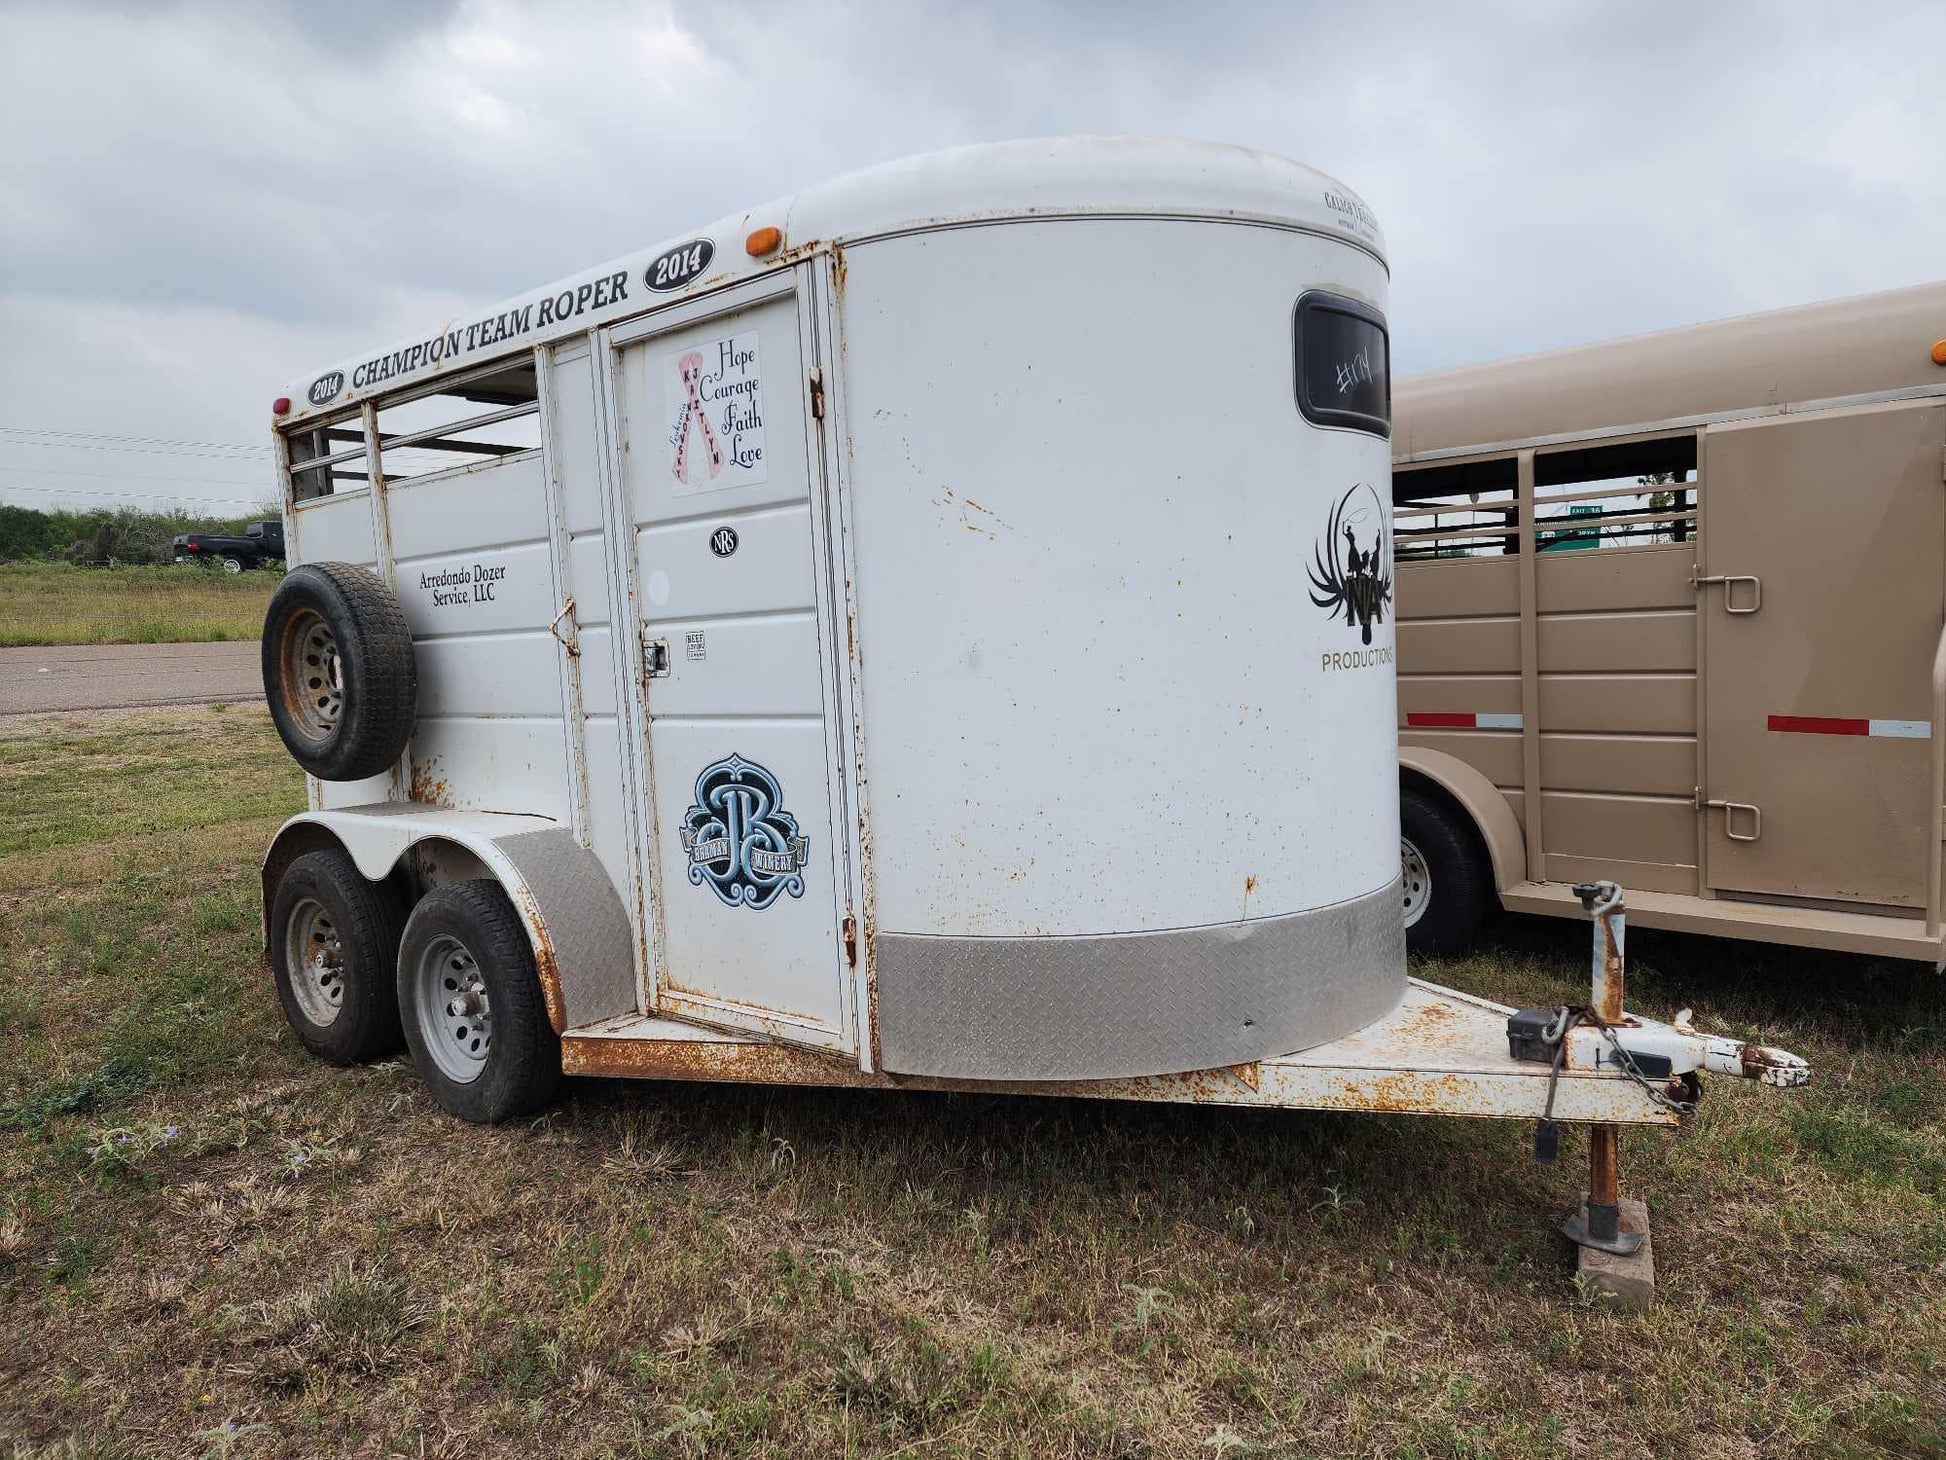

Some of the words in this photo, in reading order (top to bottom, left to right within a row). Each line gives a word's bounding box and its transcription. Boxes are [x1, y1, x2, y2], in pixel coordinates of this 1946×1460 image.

[655, 244, 703, 286] 2014
[352, 327, 465, 389] CHAMPION
[465, 303, 534, 351] TEAM
[536, 270, 629, 328] ROPER
[713, 338, 755, 382] Hope
[313, 374, 340, 400] 2014
[699, 374, 760, 402] Courage
[721, 399, 763, 436] Faith
[729, 433, 763, 469] Love
[714, 530, 735, 554] NRS
[419, 566, 471, 589] Arredondo
[473, 564, 506, 583] Dozer
[433, 586, 471, 608] Service,
[473, 582, 496, 602] LLC
[688, 633, 704, 644] BEEF
[754, 853, 793, 871] WINERY
